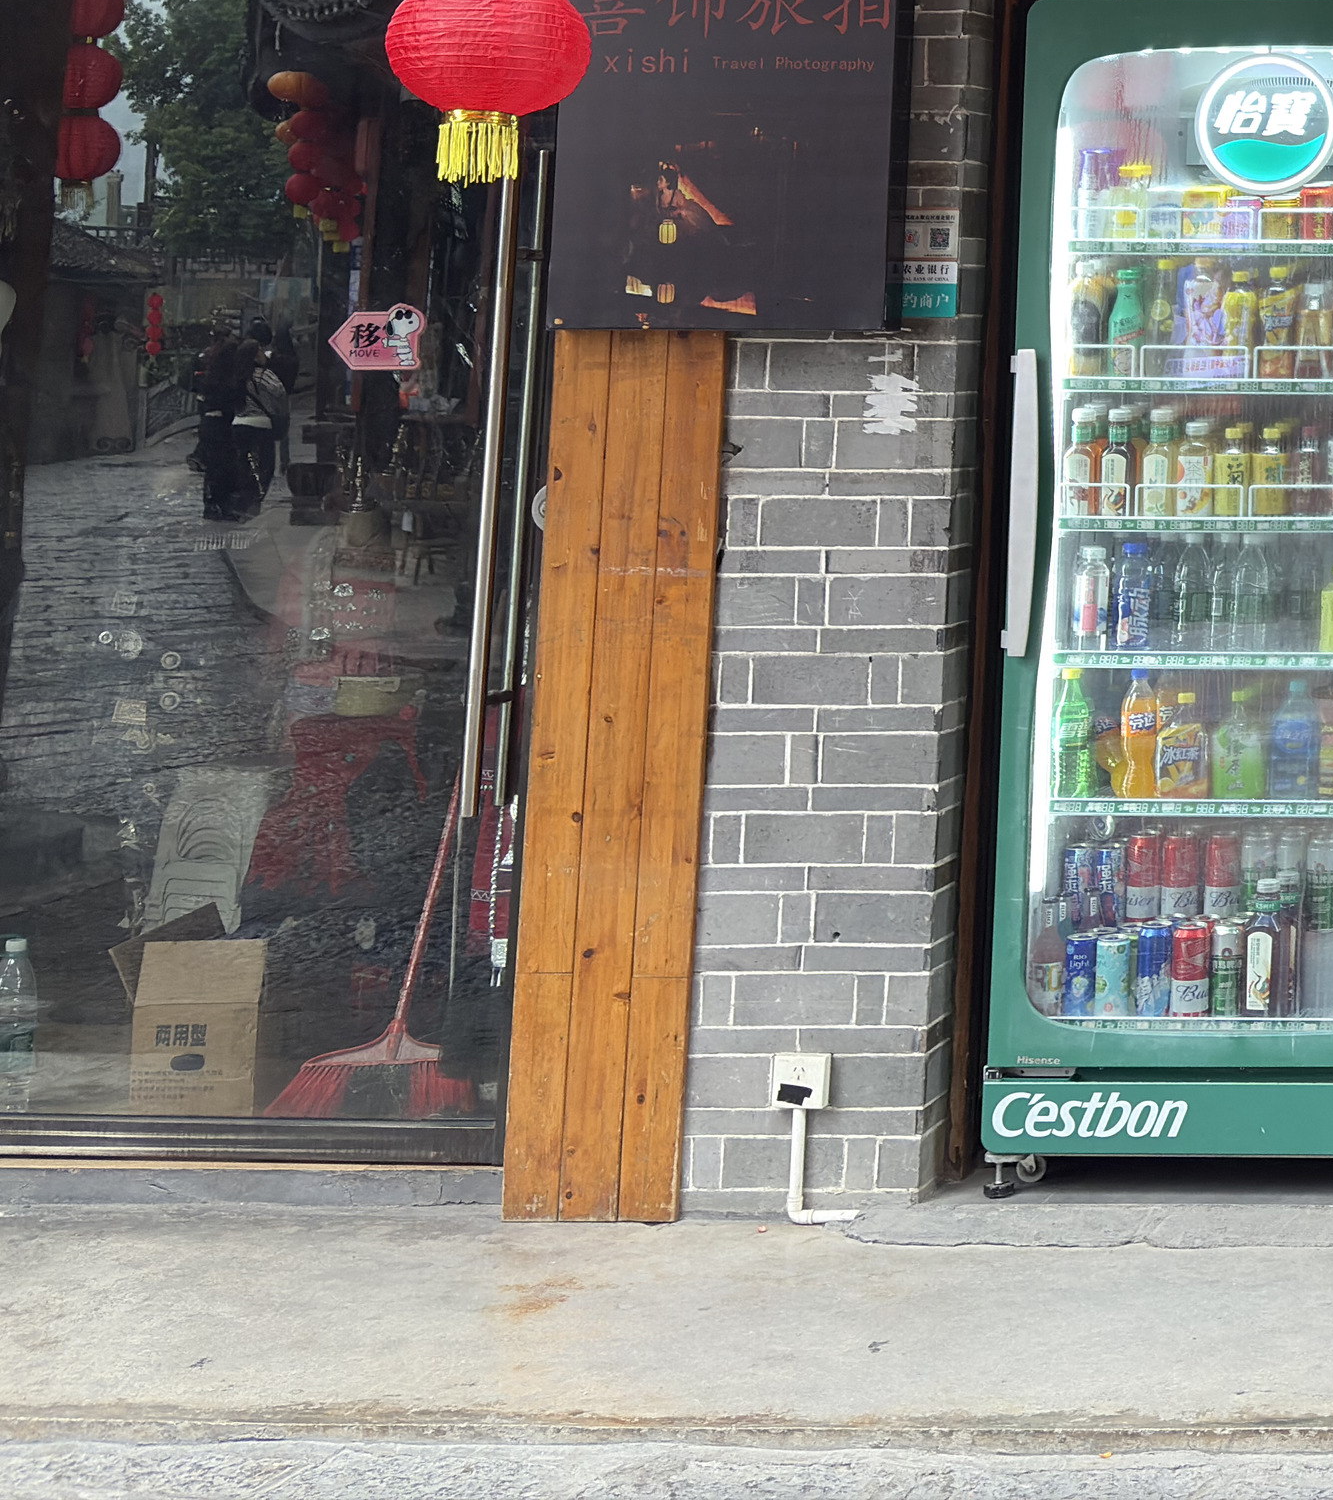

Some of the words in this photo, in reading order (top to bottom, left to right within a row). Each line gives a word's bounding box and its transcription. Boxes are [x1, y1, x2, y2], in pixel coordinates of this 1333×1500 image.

[712, 55, 766, 71] Travel
[775, 55, 875, 73] Photography
[1215, 90, 1318, 136] 怡寶
[349, 323, 381, 348] 移
[349, 349, 380, 357] MOVE
[1129, 712, 1156, 731] 芬达
[1162, 746, 1200, 764] 冰红茶
[1070, 960, 1090, 969] Light
[1016, 1055, 1061, 1065] Hisense
